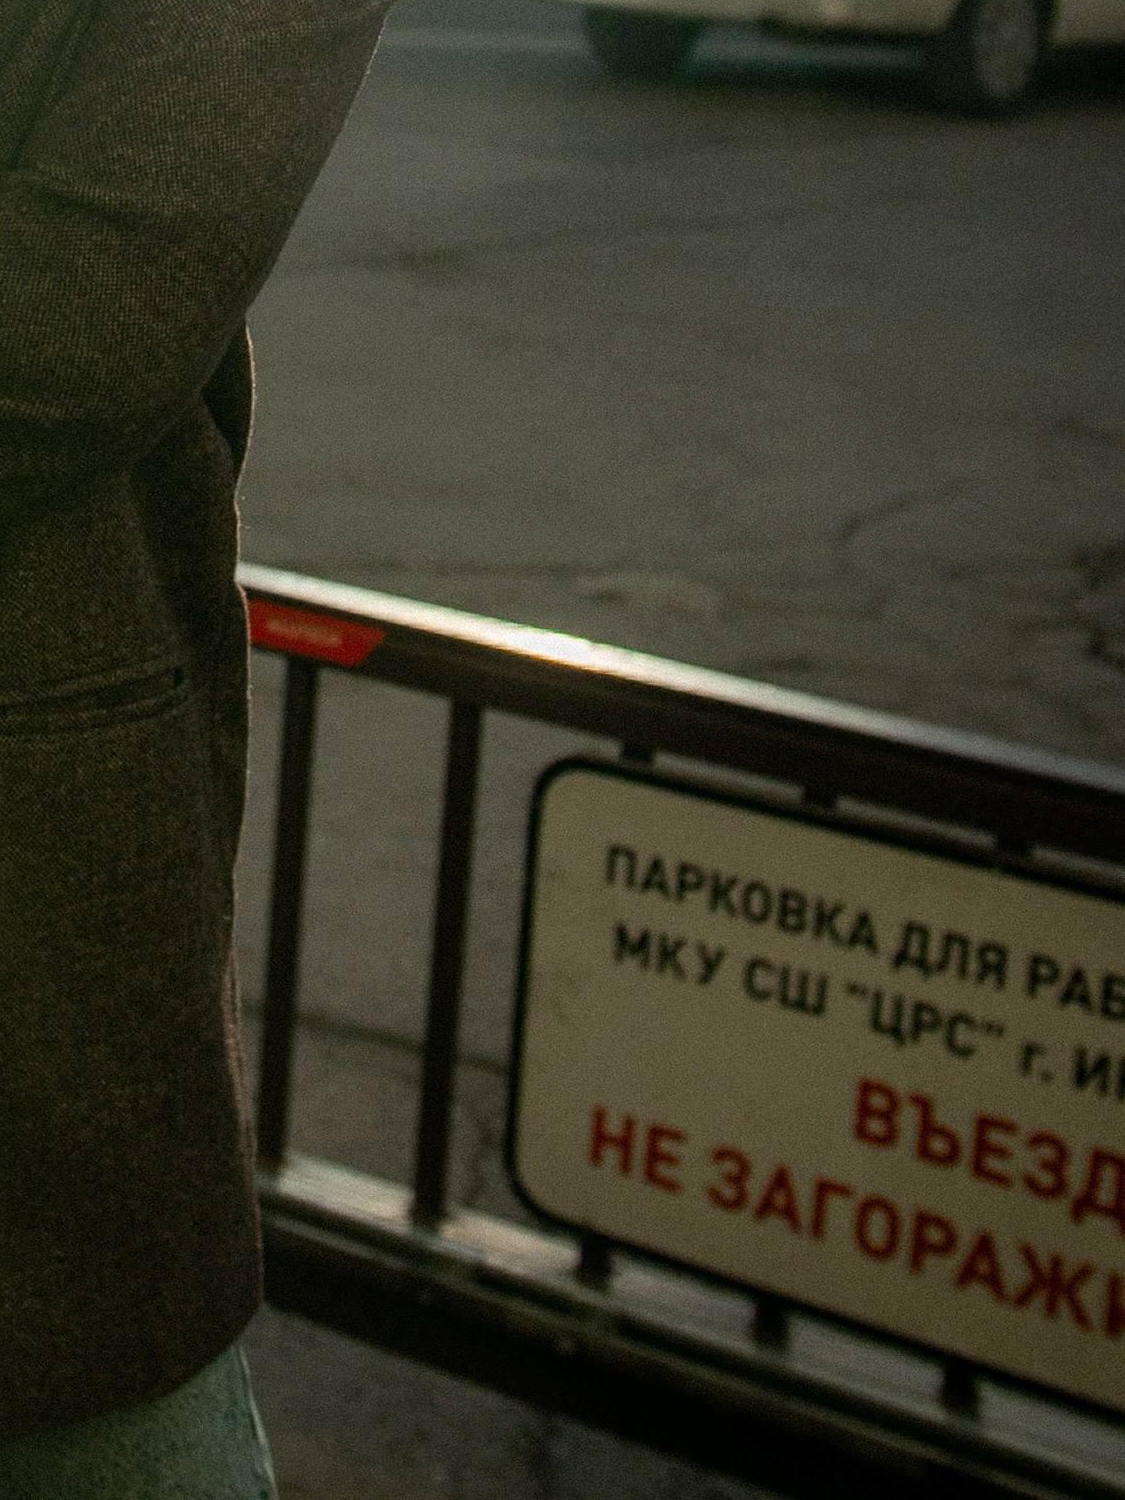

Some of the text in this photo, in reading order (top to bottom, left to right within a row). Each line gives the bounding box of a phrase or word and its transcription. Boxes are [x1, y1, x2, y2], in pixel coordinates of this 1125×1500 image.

[604, 843, 878, 953] ПАРКОВКА
[892, 920, 1008, 991] ДЛЯ
[613, 922, 724, 986] МКУ
[742, 955, 827, 1017] СШ
[844, 981, 1005, 1059] "ЦРС"
[1073, 1046, 1125, 1100] И
[588, 1104, 687, 1194] НЕ
[854, 1076, 1125, 1236] ВЪЕЗД
